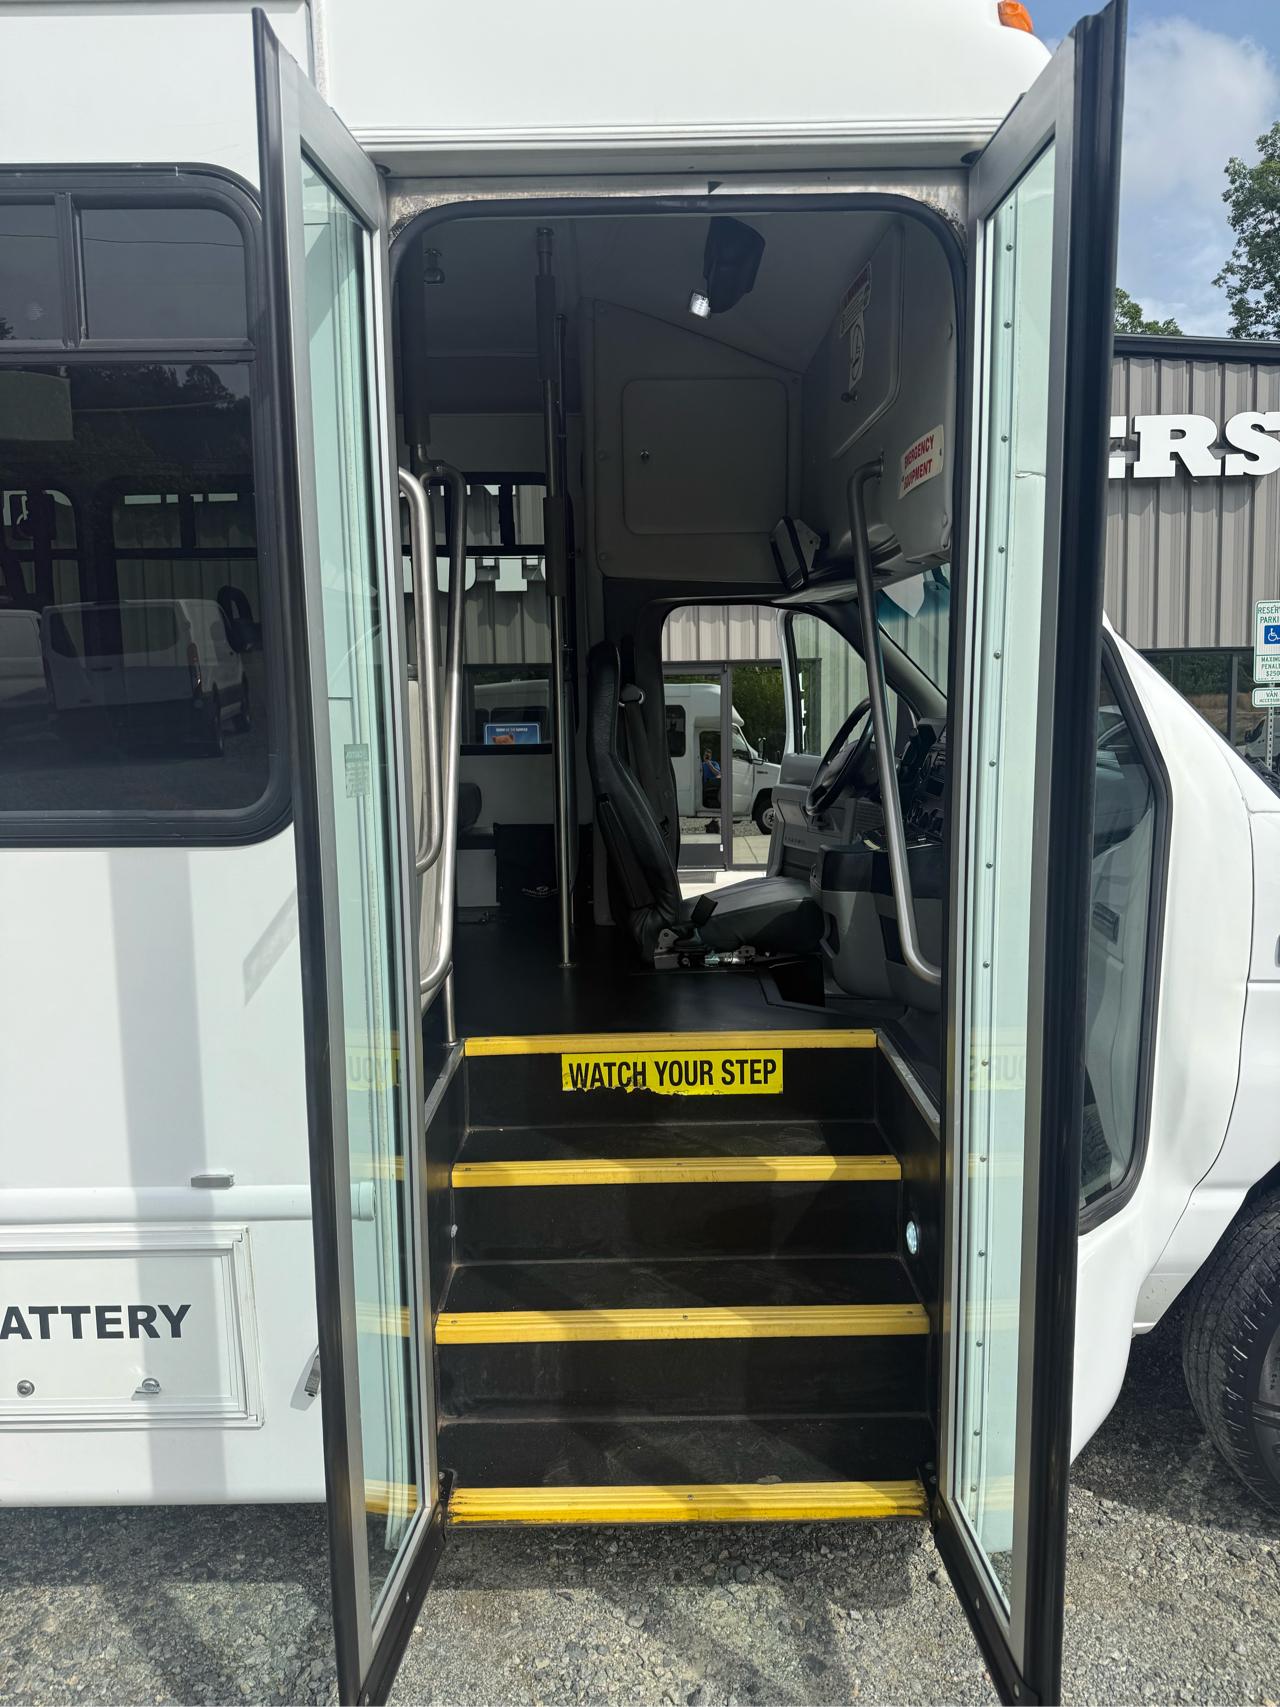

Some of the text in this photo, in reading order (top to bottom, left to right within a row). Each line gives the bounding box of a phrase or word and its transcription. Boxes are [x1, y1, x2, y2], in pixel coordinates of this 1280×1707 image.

[904, 434, 934, 470] EMERGENCY
[1108, 411, 1280, 479] RS
[1257, 606, 1280, 614] RESER
[568, 1058, 777, 1088] WATCH YOUR STEP
[0, 1304, 192, 1339] ATTERY
